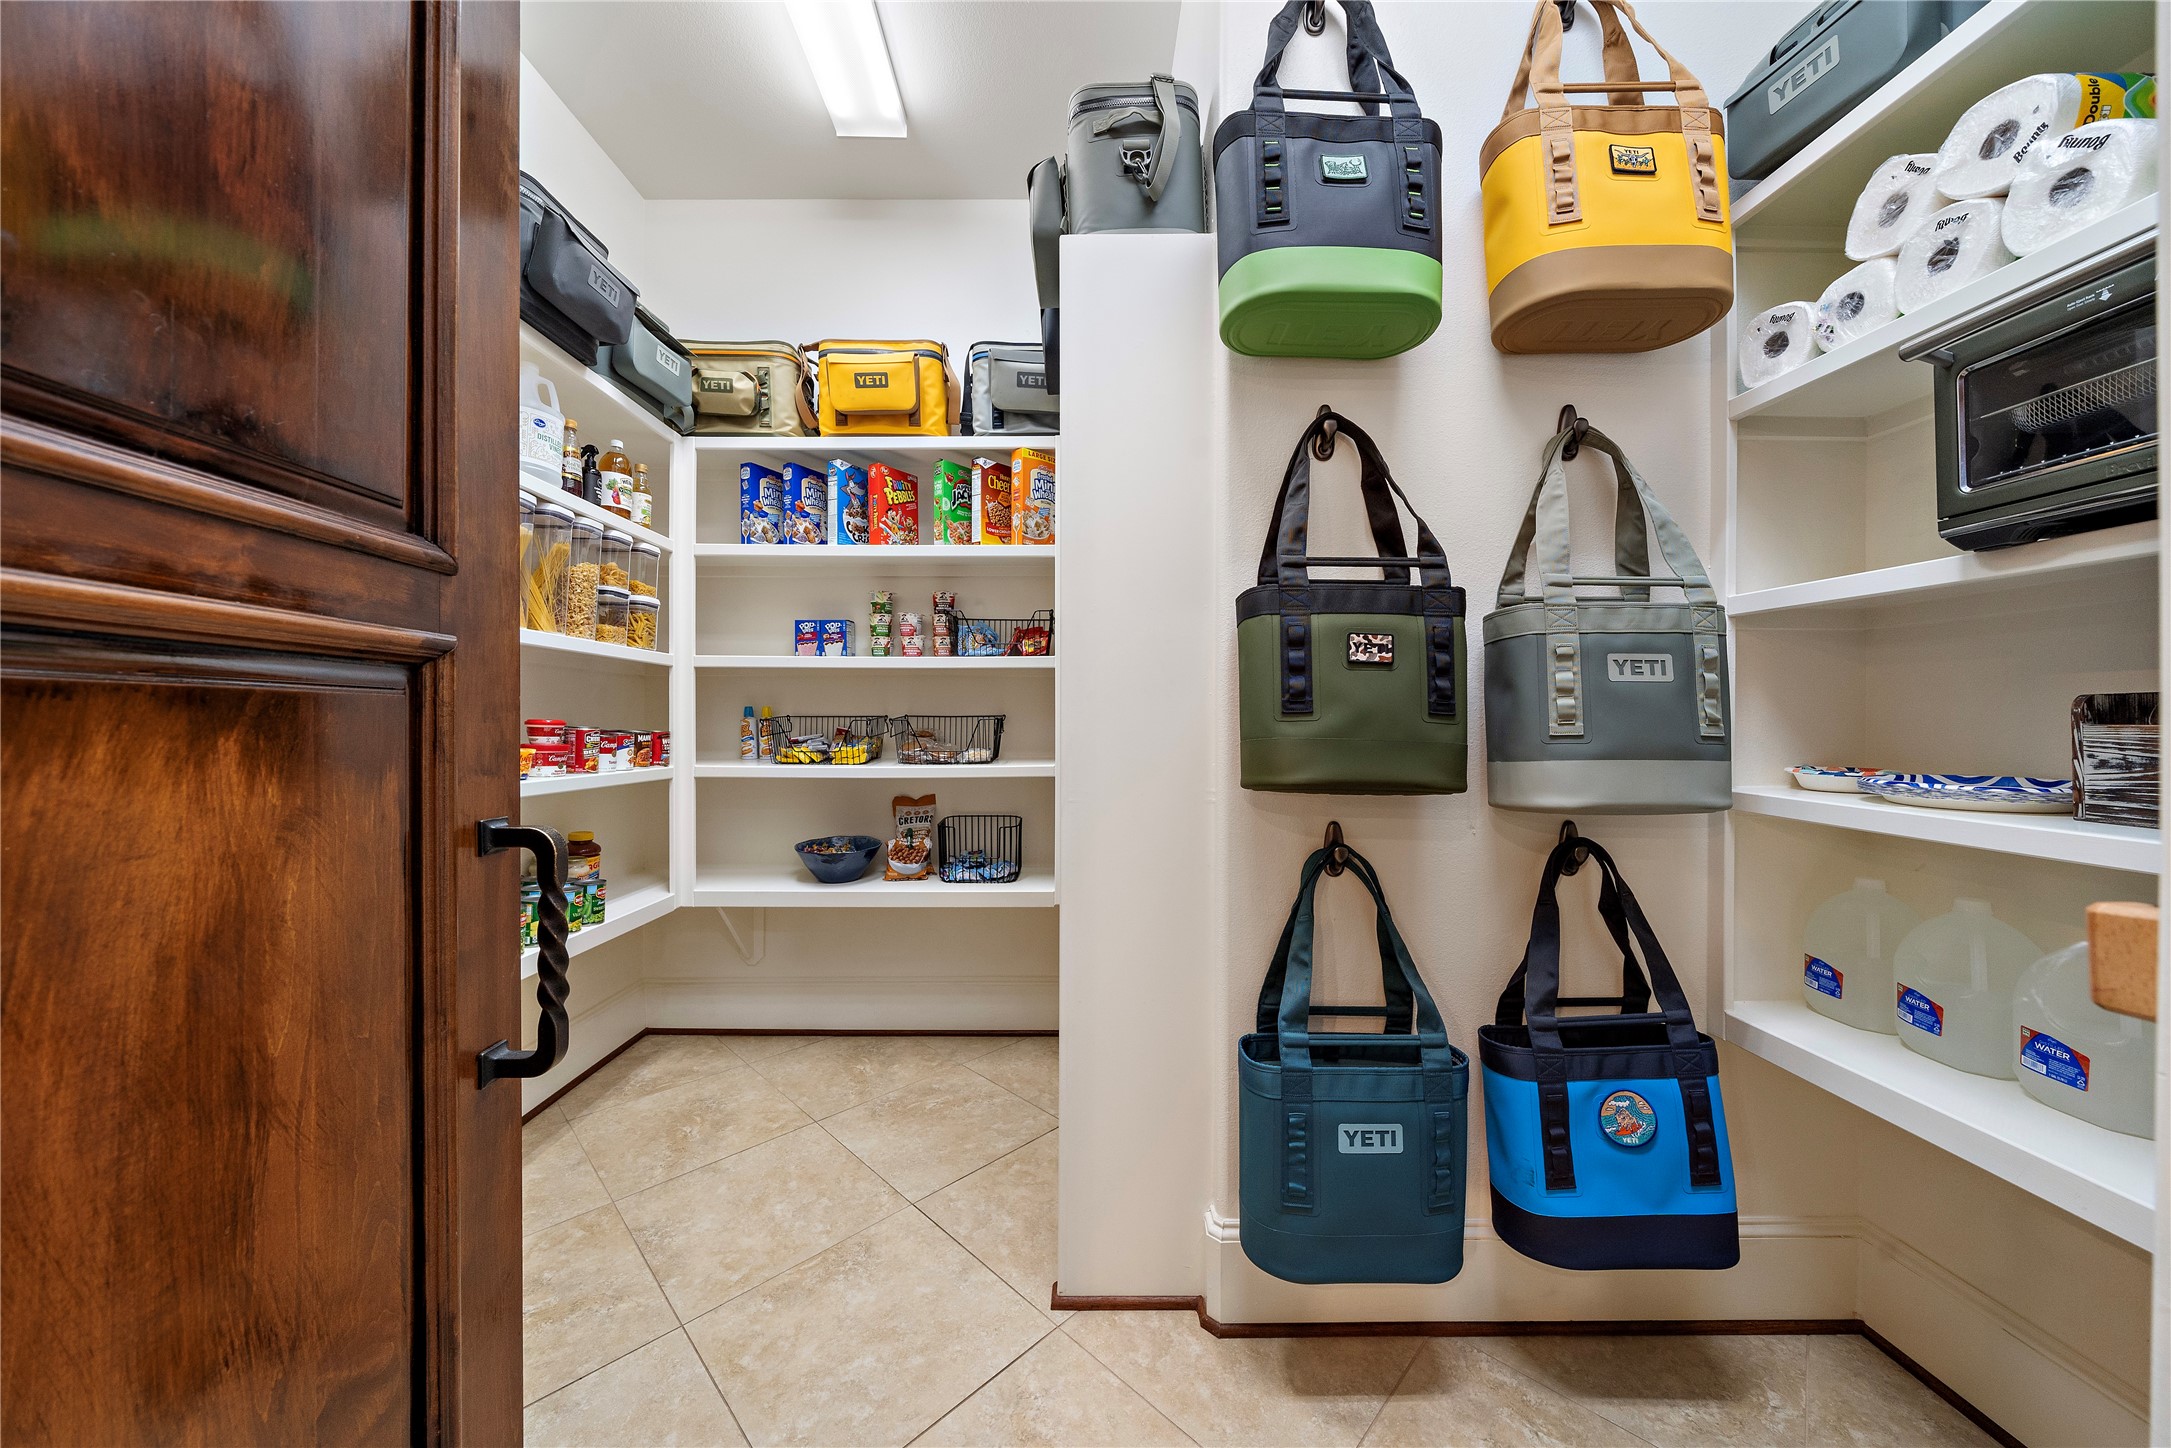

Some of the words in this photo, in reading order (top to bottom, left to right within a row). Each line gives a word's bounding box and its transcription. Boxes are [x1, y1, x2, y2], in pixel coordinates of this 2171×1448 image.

[1773, 46, 1832, 102] YETI
[2082, 78, 2101, 126] Double
[2057, 134, 2112, 151] Bounty
[593, 270, 618, 302] YETI
[659, 349, 680, 372] YETI
[702, 379, 731, 390] YETI
[856, 375, 886, 386] YETI
[1028, 450, 1046, 461] LARGE
[1047, 456, 1056, 464] SIZ
[987, 474, 1011, 493] Cheer
[1352, 642, 1391, 654] YETI
[1613, 659, 1666, 676] YETI
[898, 814, 934, 826] CRETORS
[1811, 964, 1833, 977] WATER
[1905, 995, 1930, 1011] WATER
[2034, 1041, 2071, 1061] WATER
[1343, 1130, 1396, 1147] YETI
